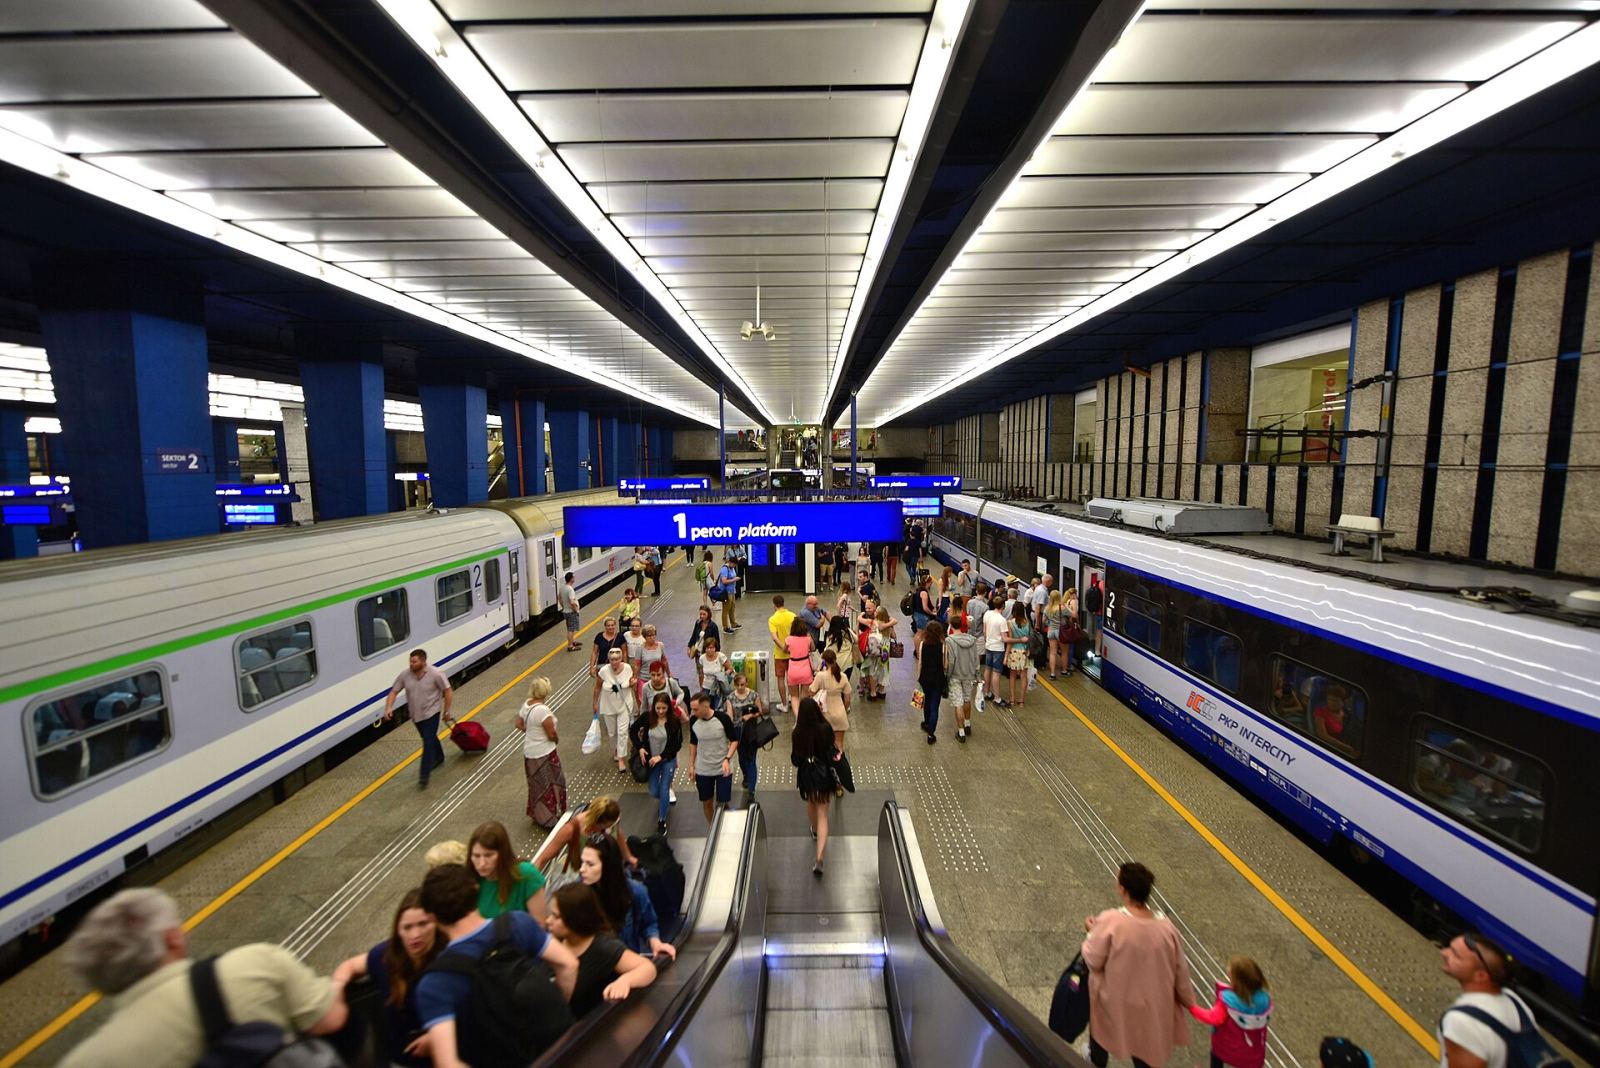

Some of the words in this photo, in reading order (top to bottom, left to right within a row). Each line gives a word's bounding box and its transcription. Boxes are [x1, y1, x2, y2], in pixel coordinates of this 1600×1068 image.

[161, 454, 187, 462] SEKTOR
[187, 453, 199, 469] 2
[620, 480, 627, 489] 5
[702, 479, 708, 489] 1
[869, 478, 876, 487] 1
[953, 477, 960, 487] 7
[283, 484, 290, 494] 3
[673, 512, 687, 538] 1
[690, 526, 732, 541] peron
[738, 522, 797, 540] platform
[473, 564, 482, 588] 2
[1109, 592, 1116, 608] 2
[1218, 713, 1239, 729] PKP
[1239, 726, 1296, 765] INTERCITY
